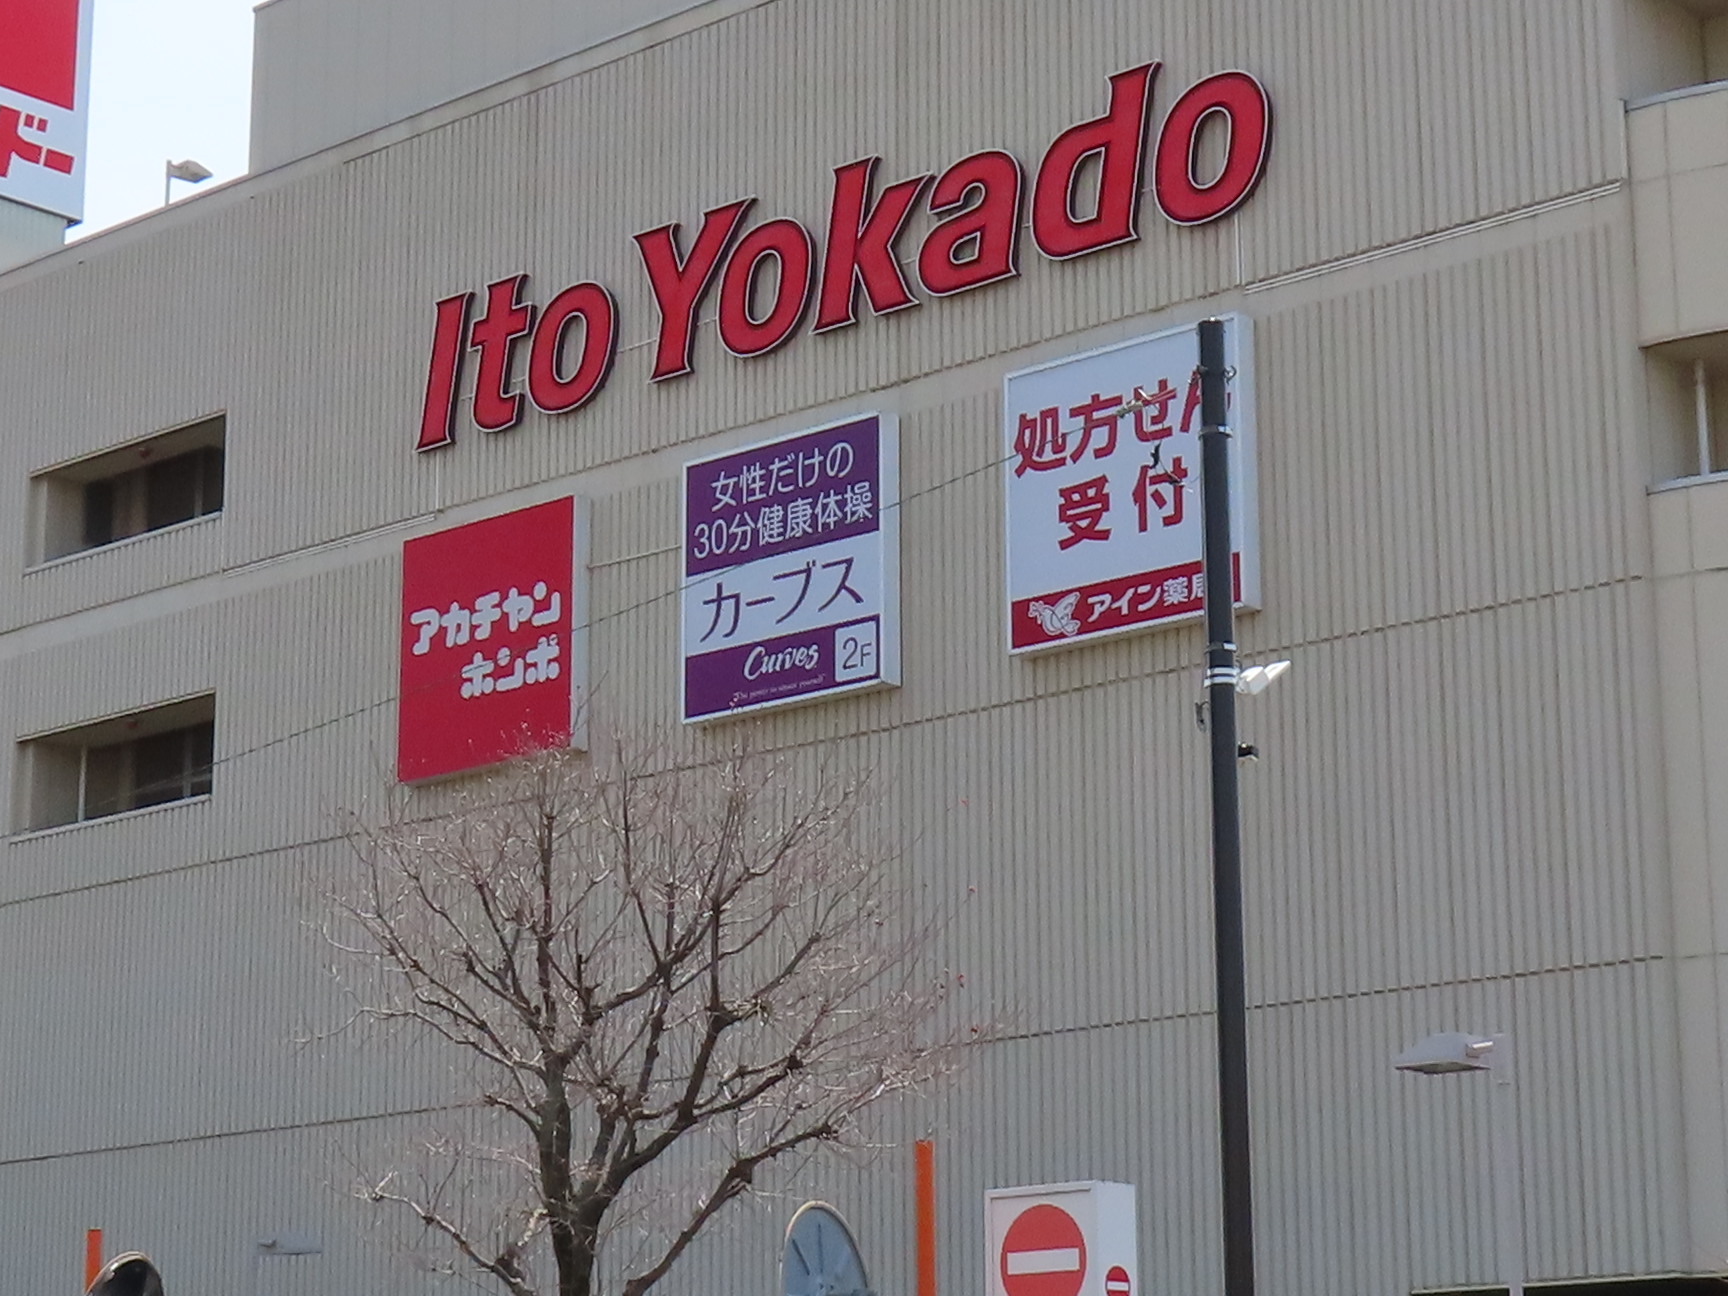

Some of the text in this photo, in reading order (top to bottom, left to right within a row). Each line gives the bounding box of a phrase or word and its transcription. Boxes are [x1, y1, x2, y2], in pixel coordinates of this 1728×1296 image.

[416, 59, 1272, 453] Ito Yokado
[710, 440, 855, 513] 女性だけの
[1057, 456, 1189, 551] 受付
[692, 481, 873, 561] 30分健康体操
[409, 580, 562, 655] アカチャン
[699, 556, 865, 644] カーブス
[459, 634, 562, 700] ホンポ
[743, 643, 820, 681] Curves
[842, 636, 873, 671] 2F
